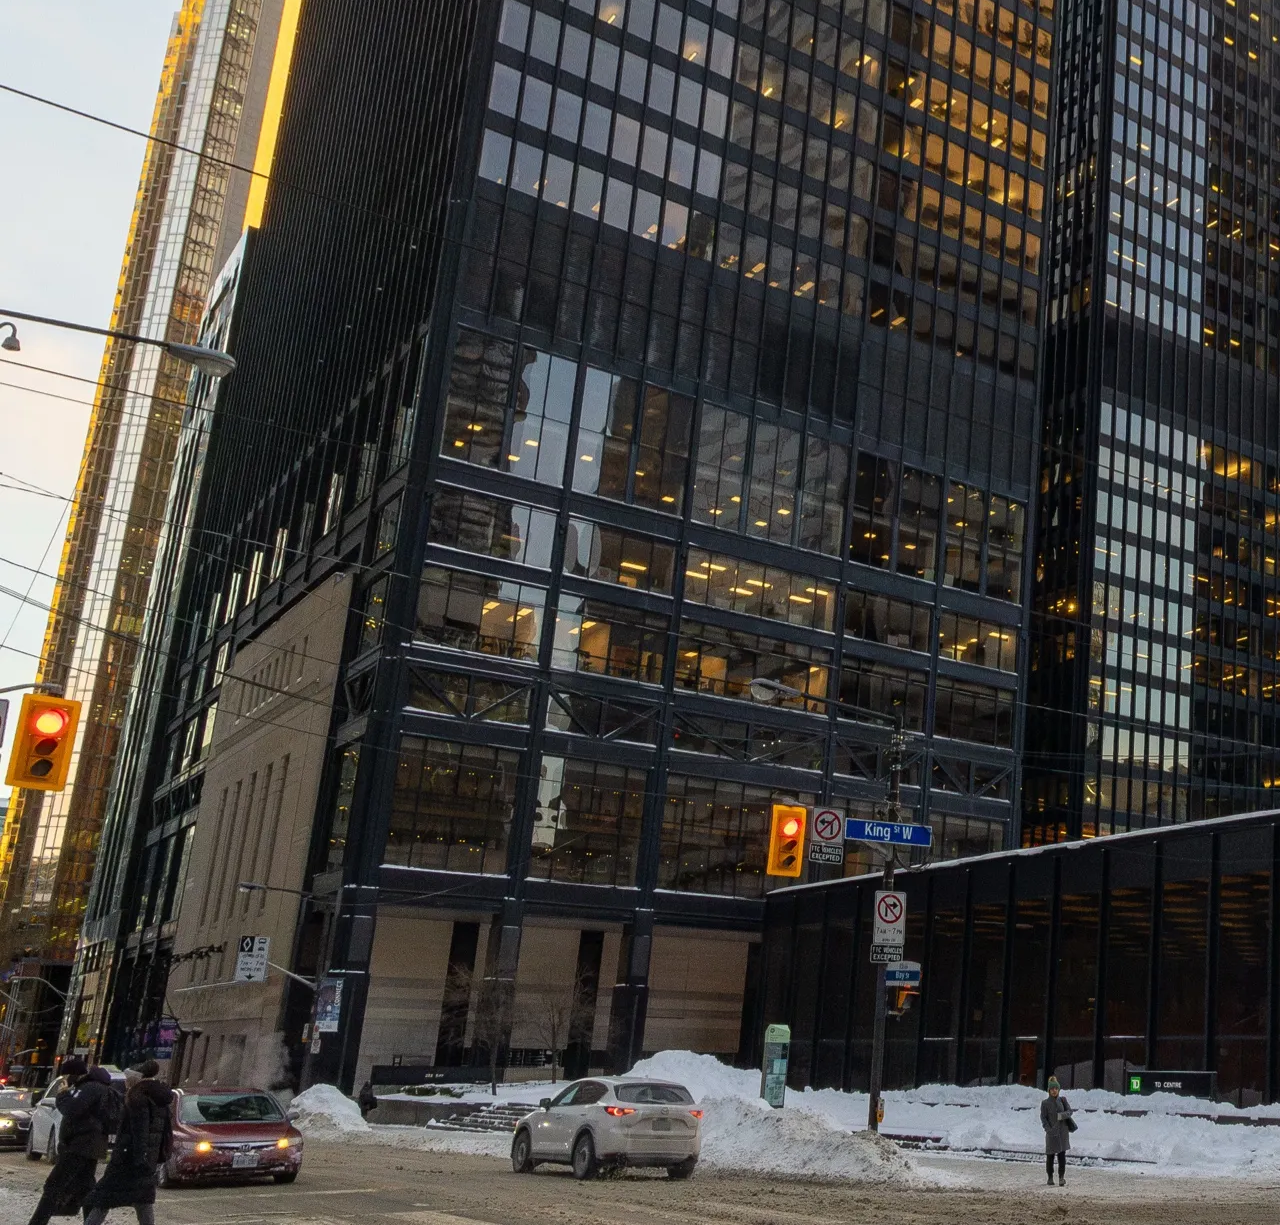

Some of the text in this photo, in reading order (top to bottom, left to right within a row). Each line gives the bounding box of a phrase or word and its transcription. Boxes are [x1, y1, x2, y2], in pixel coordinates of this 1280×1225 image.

[864, 822, 913, 841] King St W
[811, 845, 842, 854] TTC VEHICLES
[811, 852, 841, 862] EXCEPTED
[883, 946, 902, 954] VEHICLES
[895, 971, 905, 981] Bay
[334, 979, 344, 1007] CONNECT
[1132, 1080, 1140, 1089] TD
